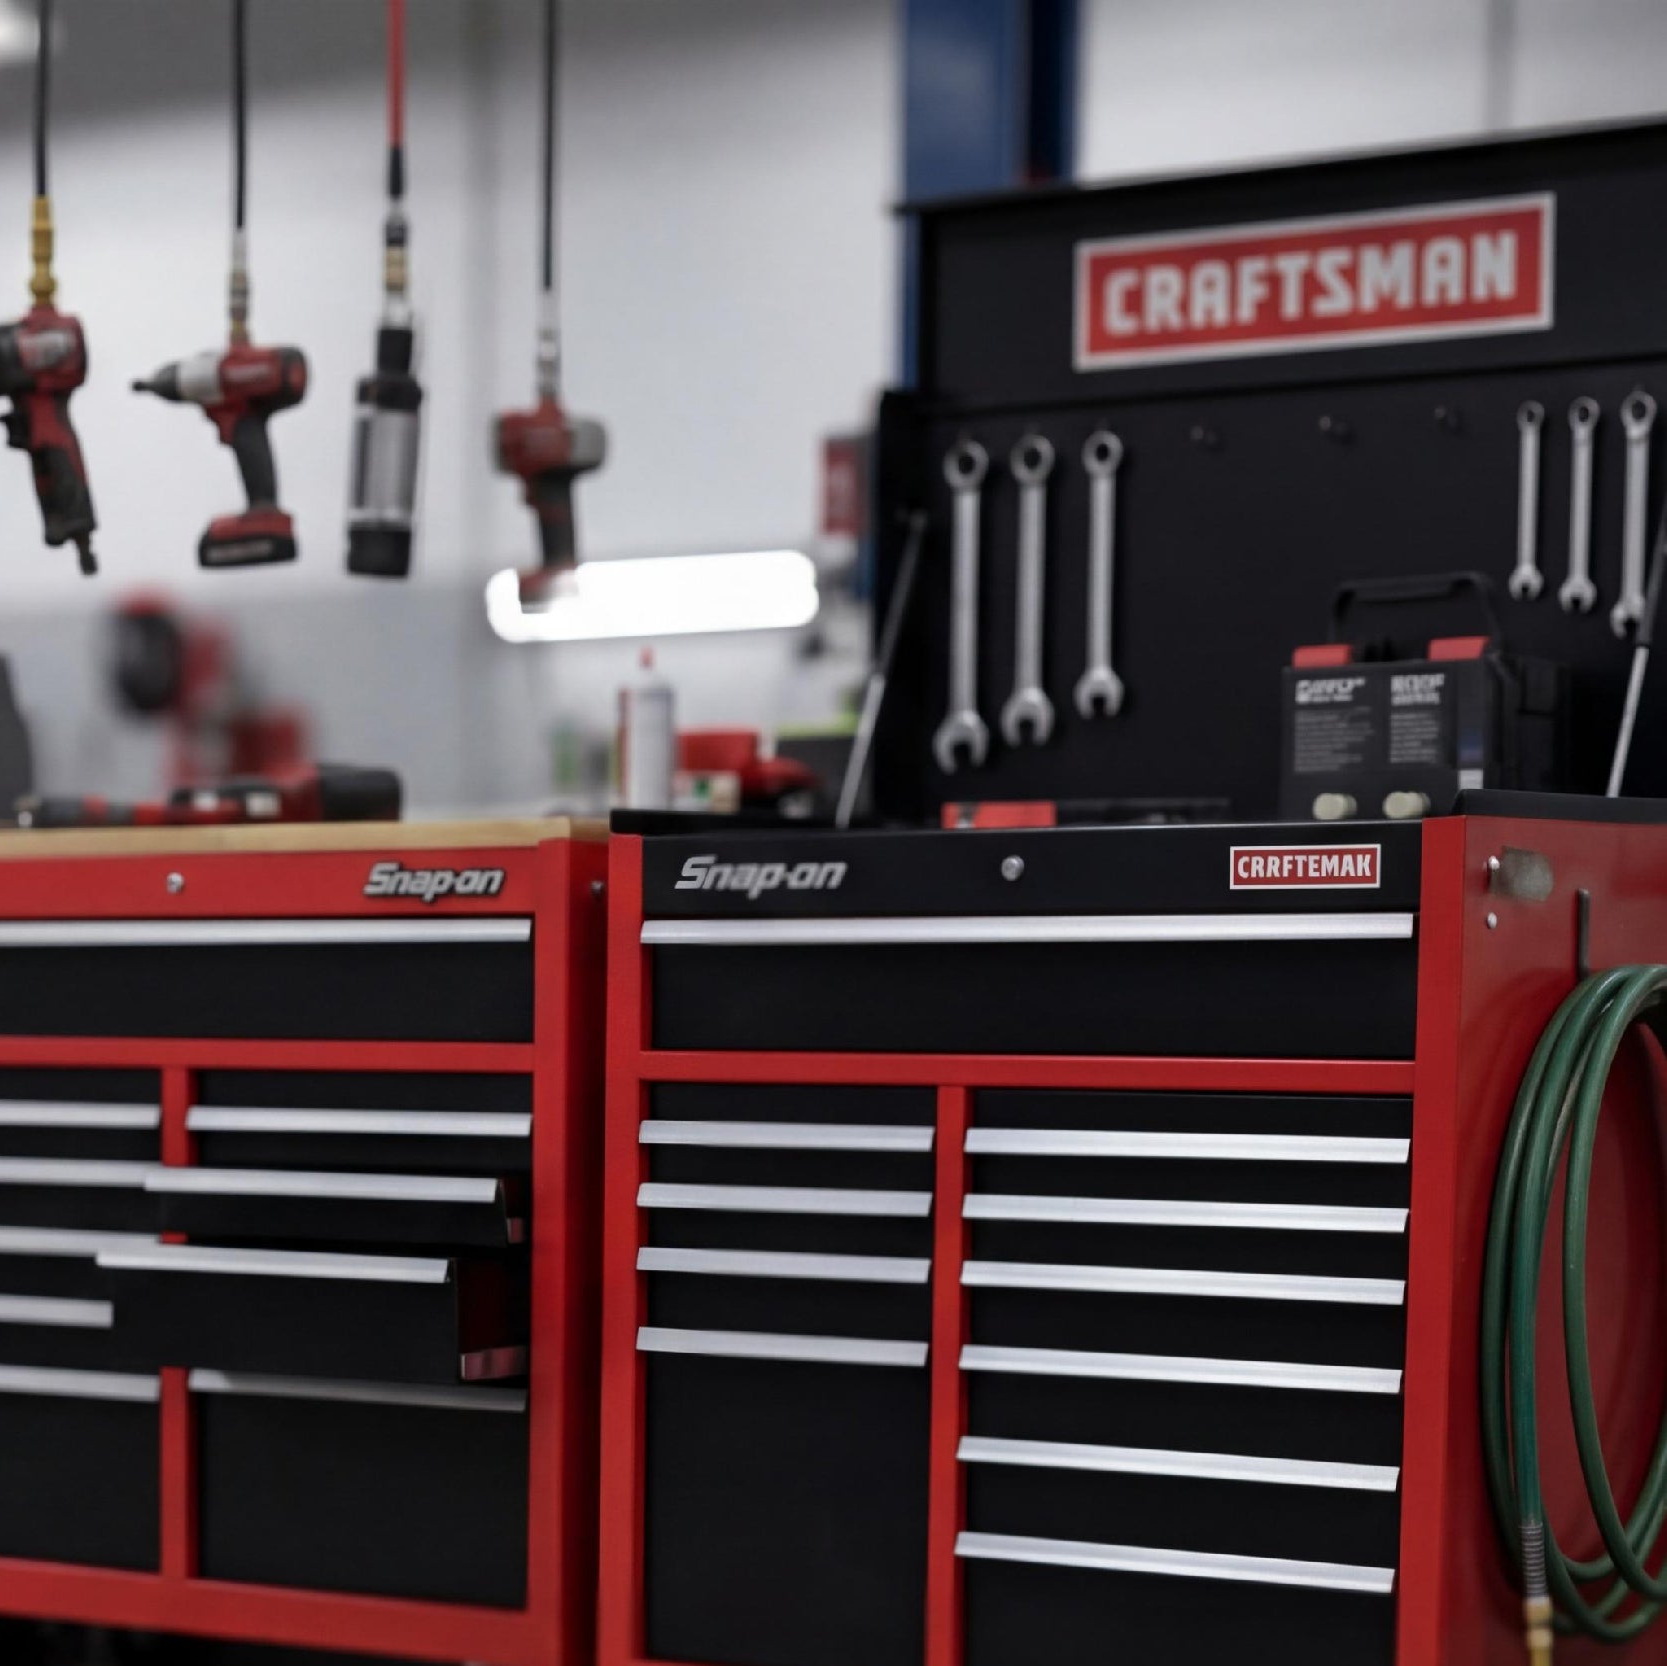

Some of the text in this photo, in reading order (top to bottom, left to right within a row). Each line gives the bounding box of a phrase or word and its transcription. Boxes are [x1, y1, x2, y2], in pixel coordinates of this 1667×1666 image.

[1102, 231, 1518, 337] CRAFTSMAN
[363, 861, 505, 903] Snap-on
[674, 854, 847, 899] Snap-on
